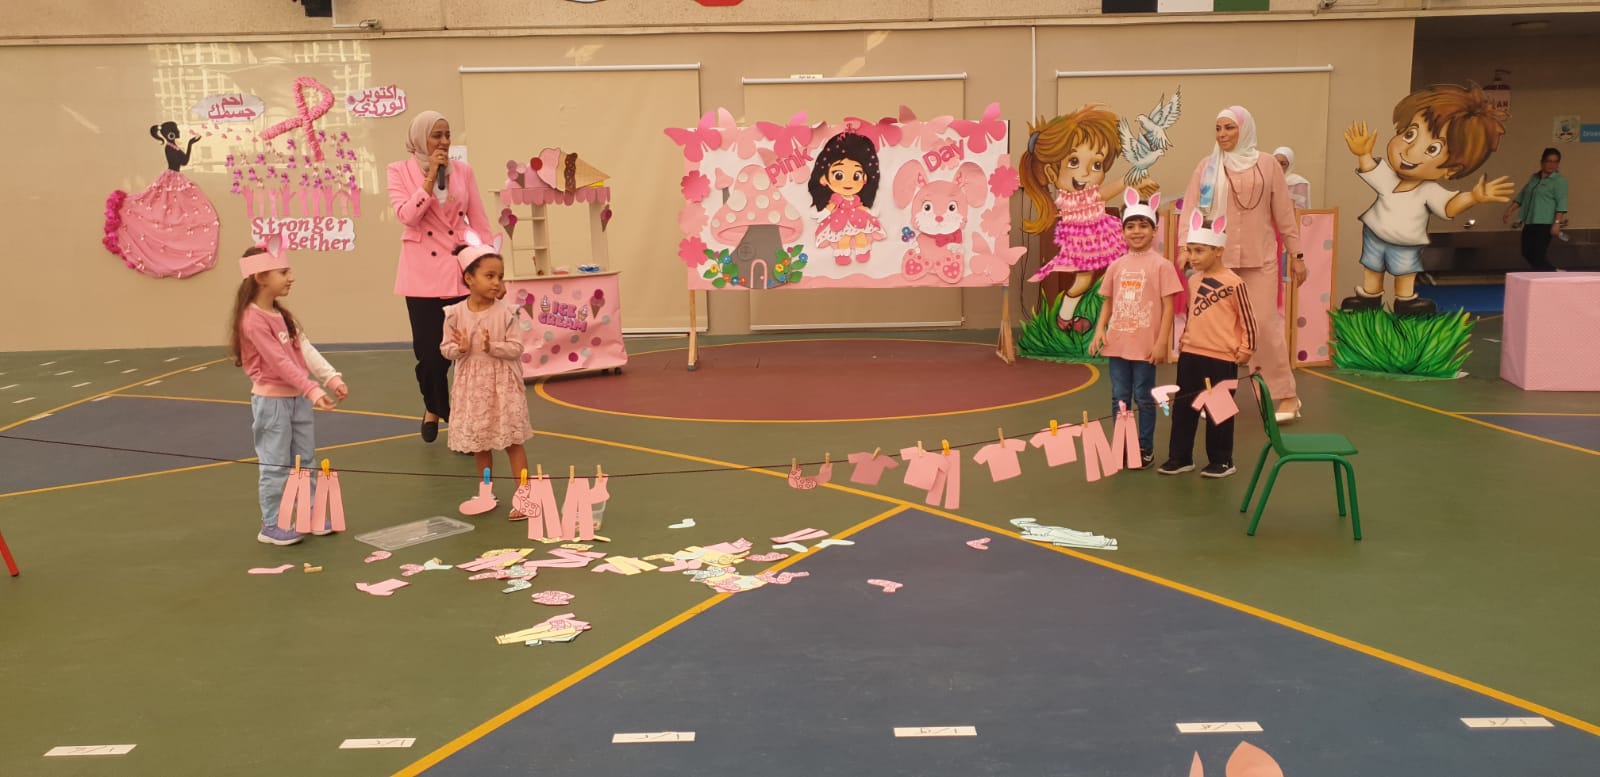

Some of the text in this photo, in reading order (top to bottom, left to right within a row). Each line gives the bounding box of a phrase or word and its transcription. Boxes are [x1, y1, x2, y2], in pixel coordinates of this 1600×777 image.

[208, 103, 257, 121] جسمك
[353, 95, 407, 117] الوردي
[922, 139, 965, 172] Day
[252, 216, 347, 236] Stronger
[259, 231, 350, 251] Tgether
[552, 301, 578, 319] ICE
[1193, 285, 1234, 317] adidas
[538, 312, 588, 333] CREAM
